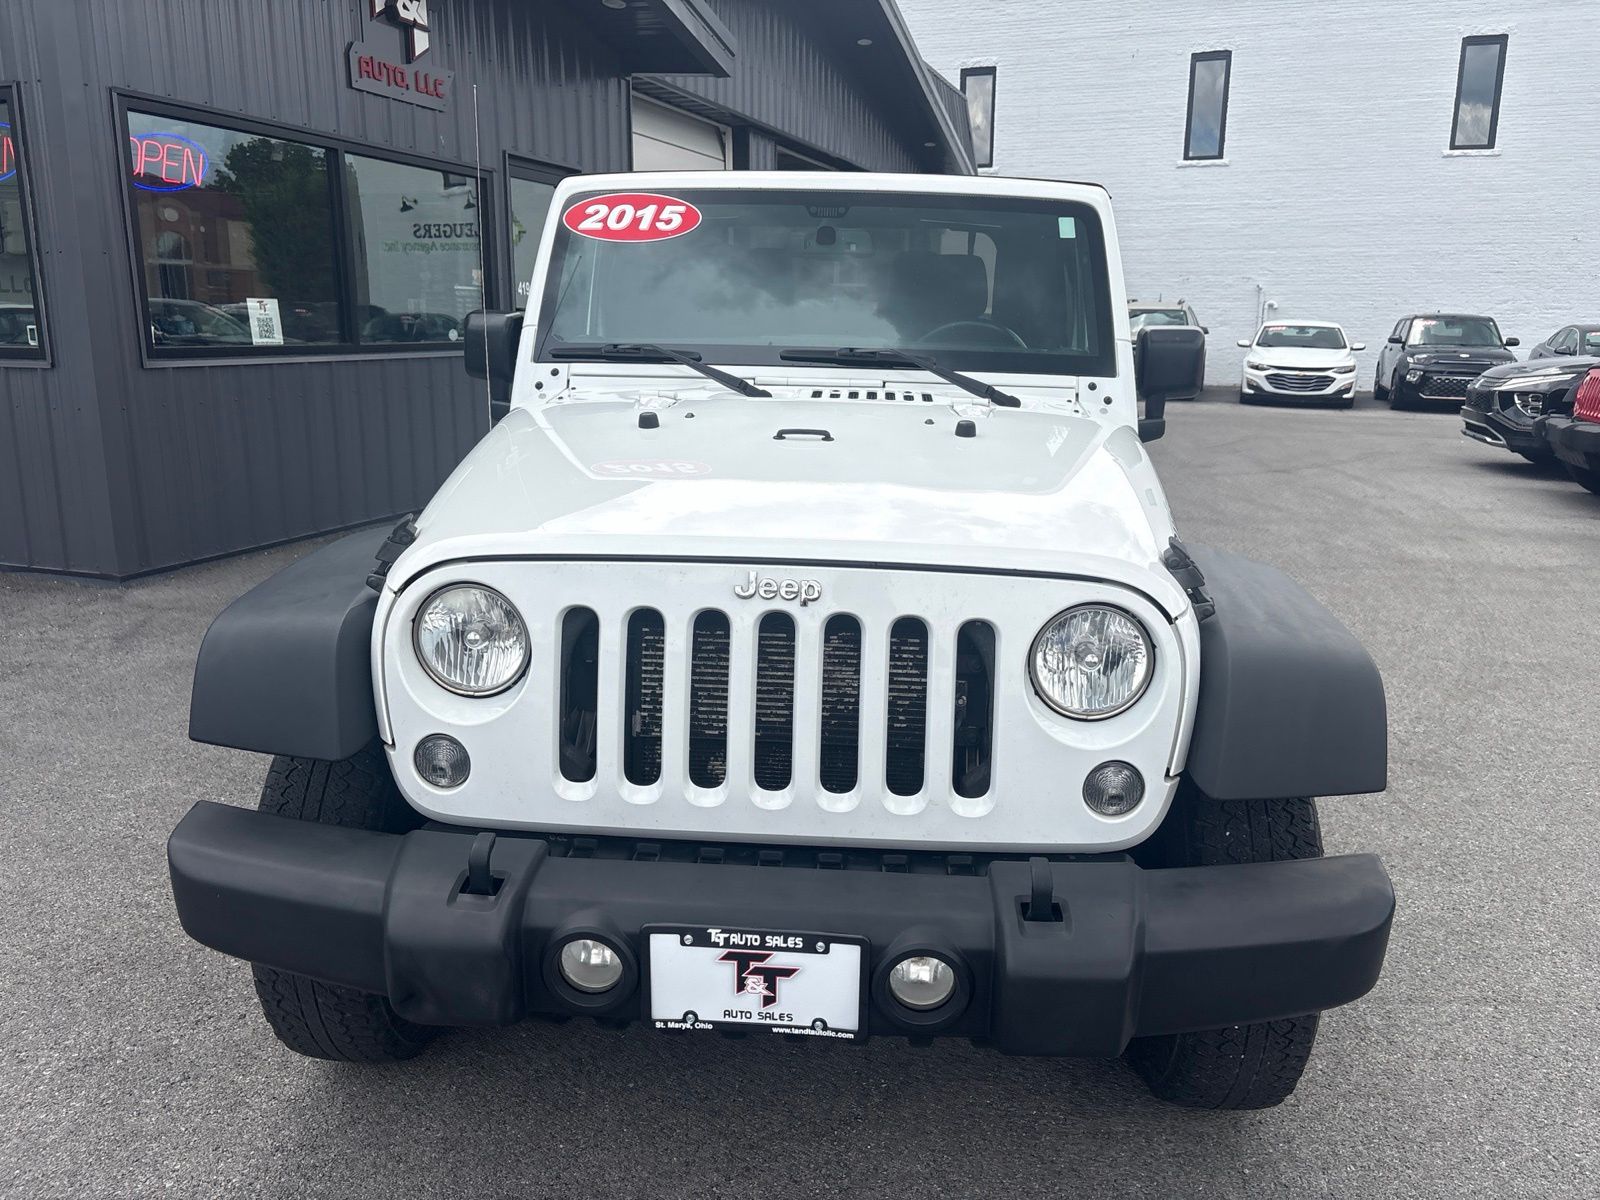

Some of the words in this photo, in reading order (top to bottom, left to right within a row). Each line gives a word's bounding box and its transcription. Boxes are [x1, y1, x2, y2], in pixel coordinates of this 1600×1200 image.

[414, 70, 445, 99] LLC
[577, 203, 687, 231] 2015
[734, 570, 822, 607] Jeep
[729, 932, 761, 947] AUTO
[764, 935, 804, 949] SALES
[716, 949, 802, 1010] T&T
[655, 1021, 666, 1029] St.
[694, 1022, 714, 1030] Ohio
[723, 1009, 753, 1021] AUTO
[757, 1012, 794, 1022] SALES
